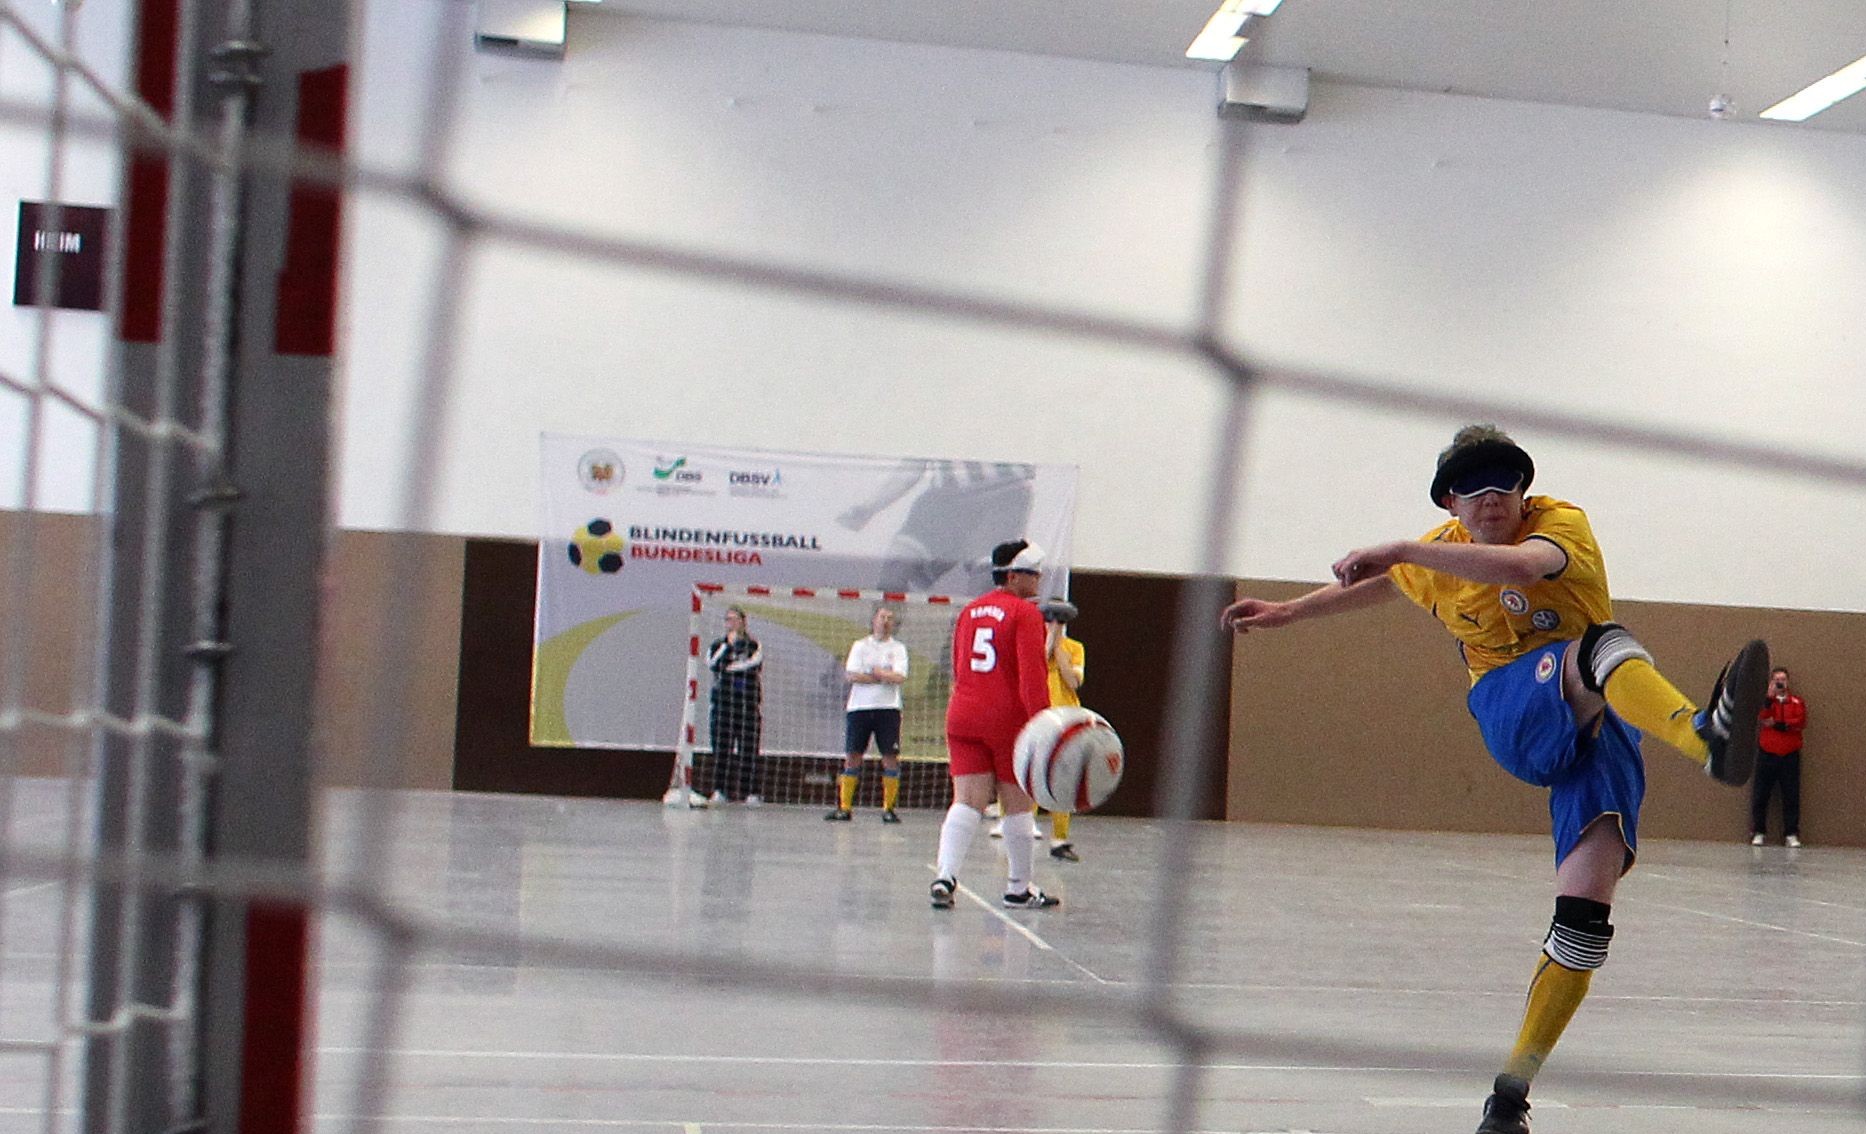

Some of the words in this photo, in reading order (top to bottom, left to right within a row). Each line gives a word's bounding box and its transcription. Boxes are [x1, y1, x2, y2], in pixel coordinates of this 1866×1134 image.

[34, 229, 80, 253] HEIM
[630, 525, 822, 550] BLINDENFUSSBALL
[631, 545, 763, 565] BUNDESLIGA
[970, 627, 997, 673] 5
